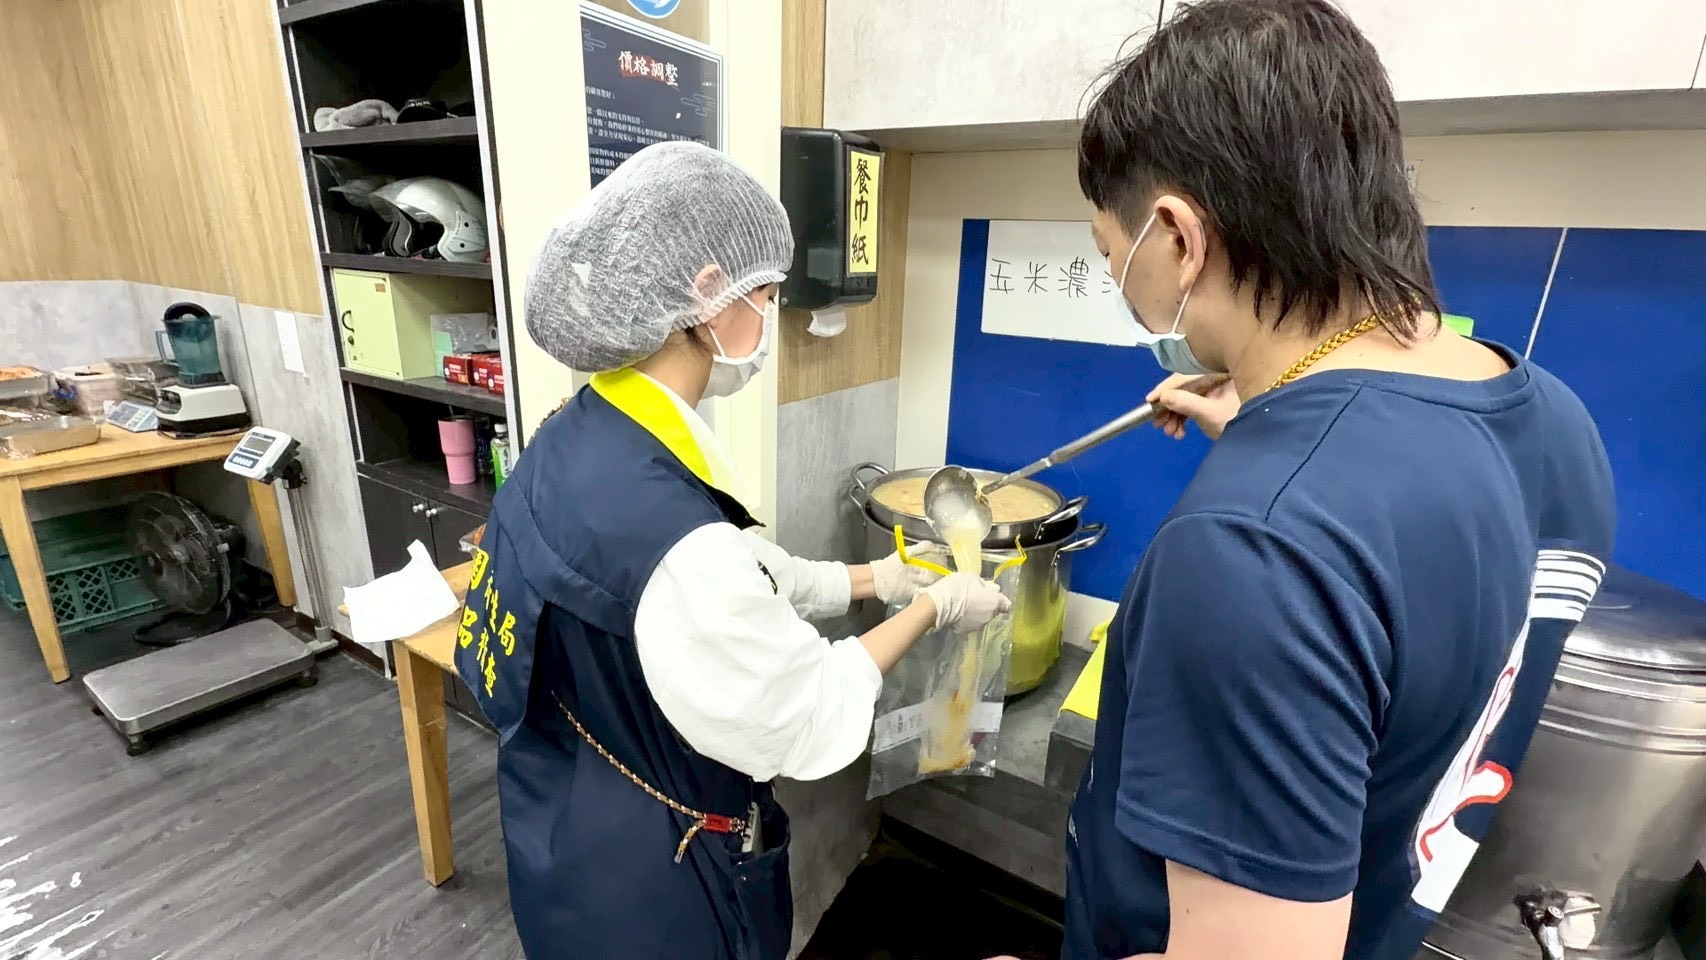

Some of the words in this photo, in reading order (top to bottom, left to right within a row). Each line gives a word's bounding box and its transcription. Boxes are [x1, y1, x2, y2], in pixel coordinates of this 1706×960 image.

[618, 51, 678, 86] 價格調整
[851, 158, 871, 265] 餐巾紙
